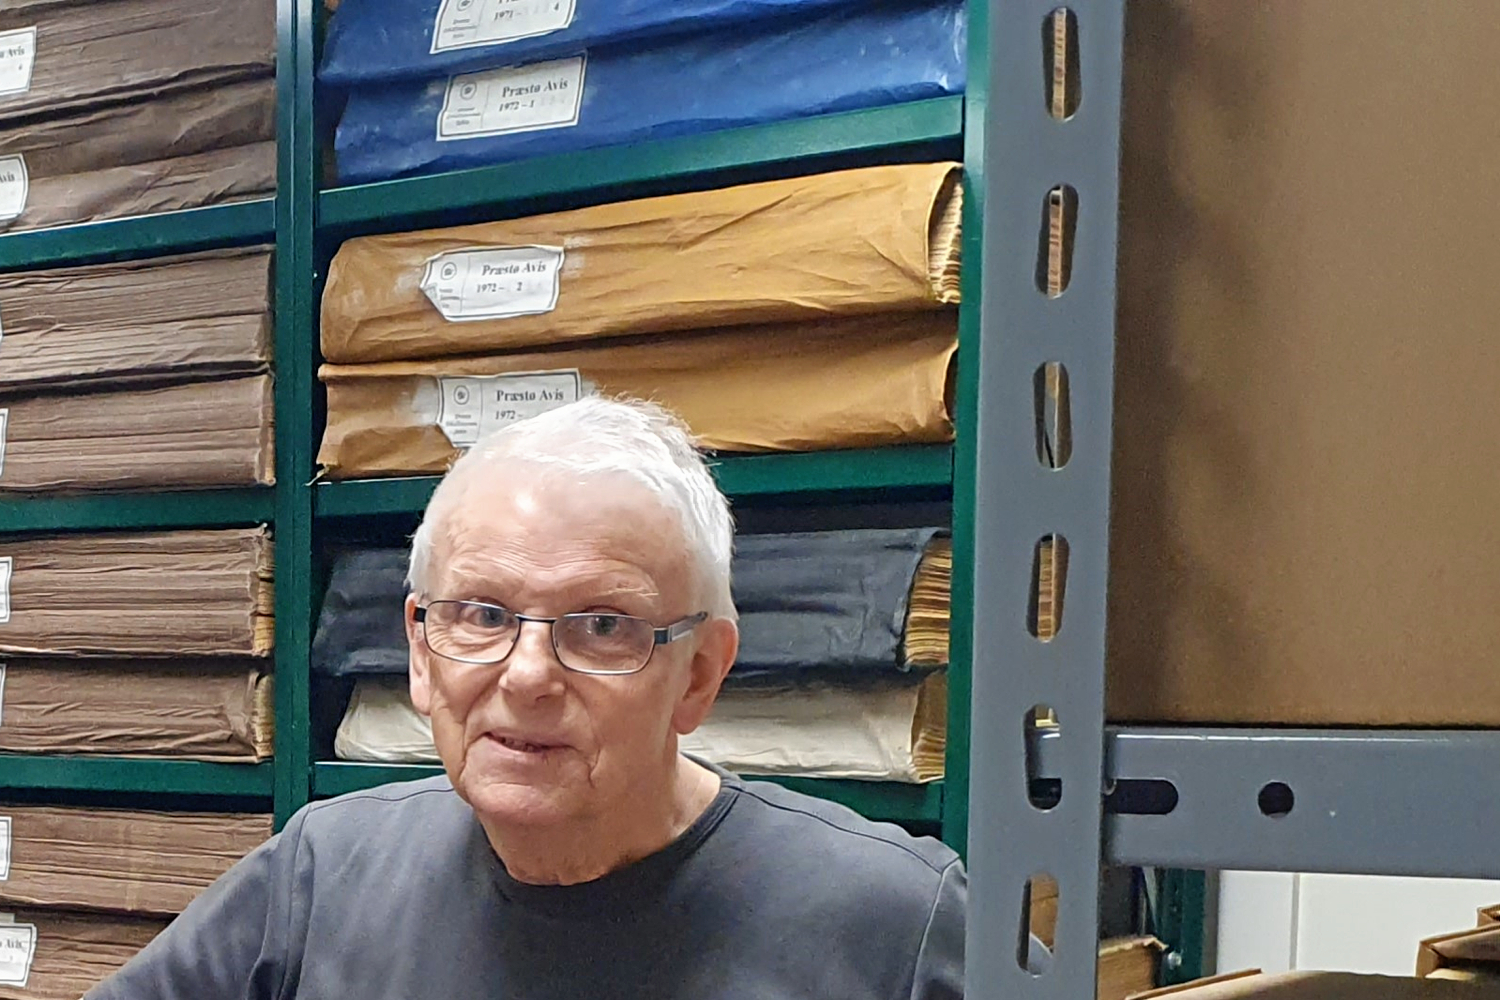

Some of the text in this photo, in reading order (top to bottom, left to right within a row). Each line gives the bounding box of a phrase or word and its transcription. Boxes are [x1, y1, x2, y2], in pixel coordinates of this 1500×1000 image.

[543, 78, 568, 91] Avis
[522, 261, 547, 273] Avis
[539, 388, 564, 400] Avis
[495, 411, 515, 420] 1972
